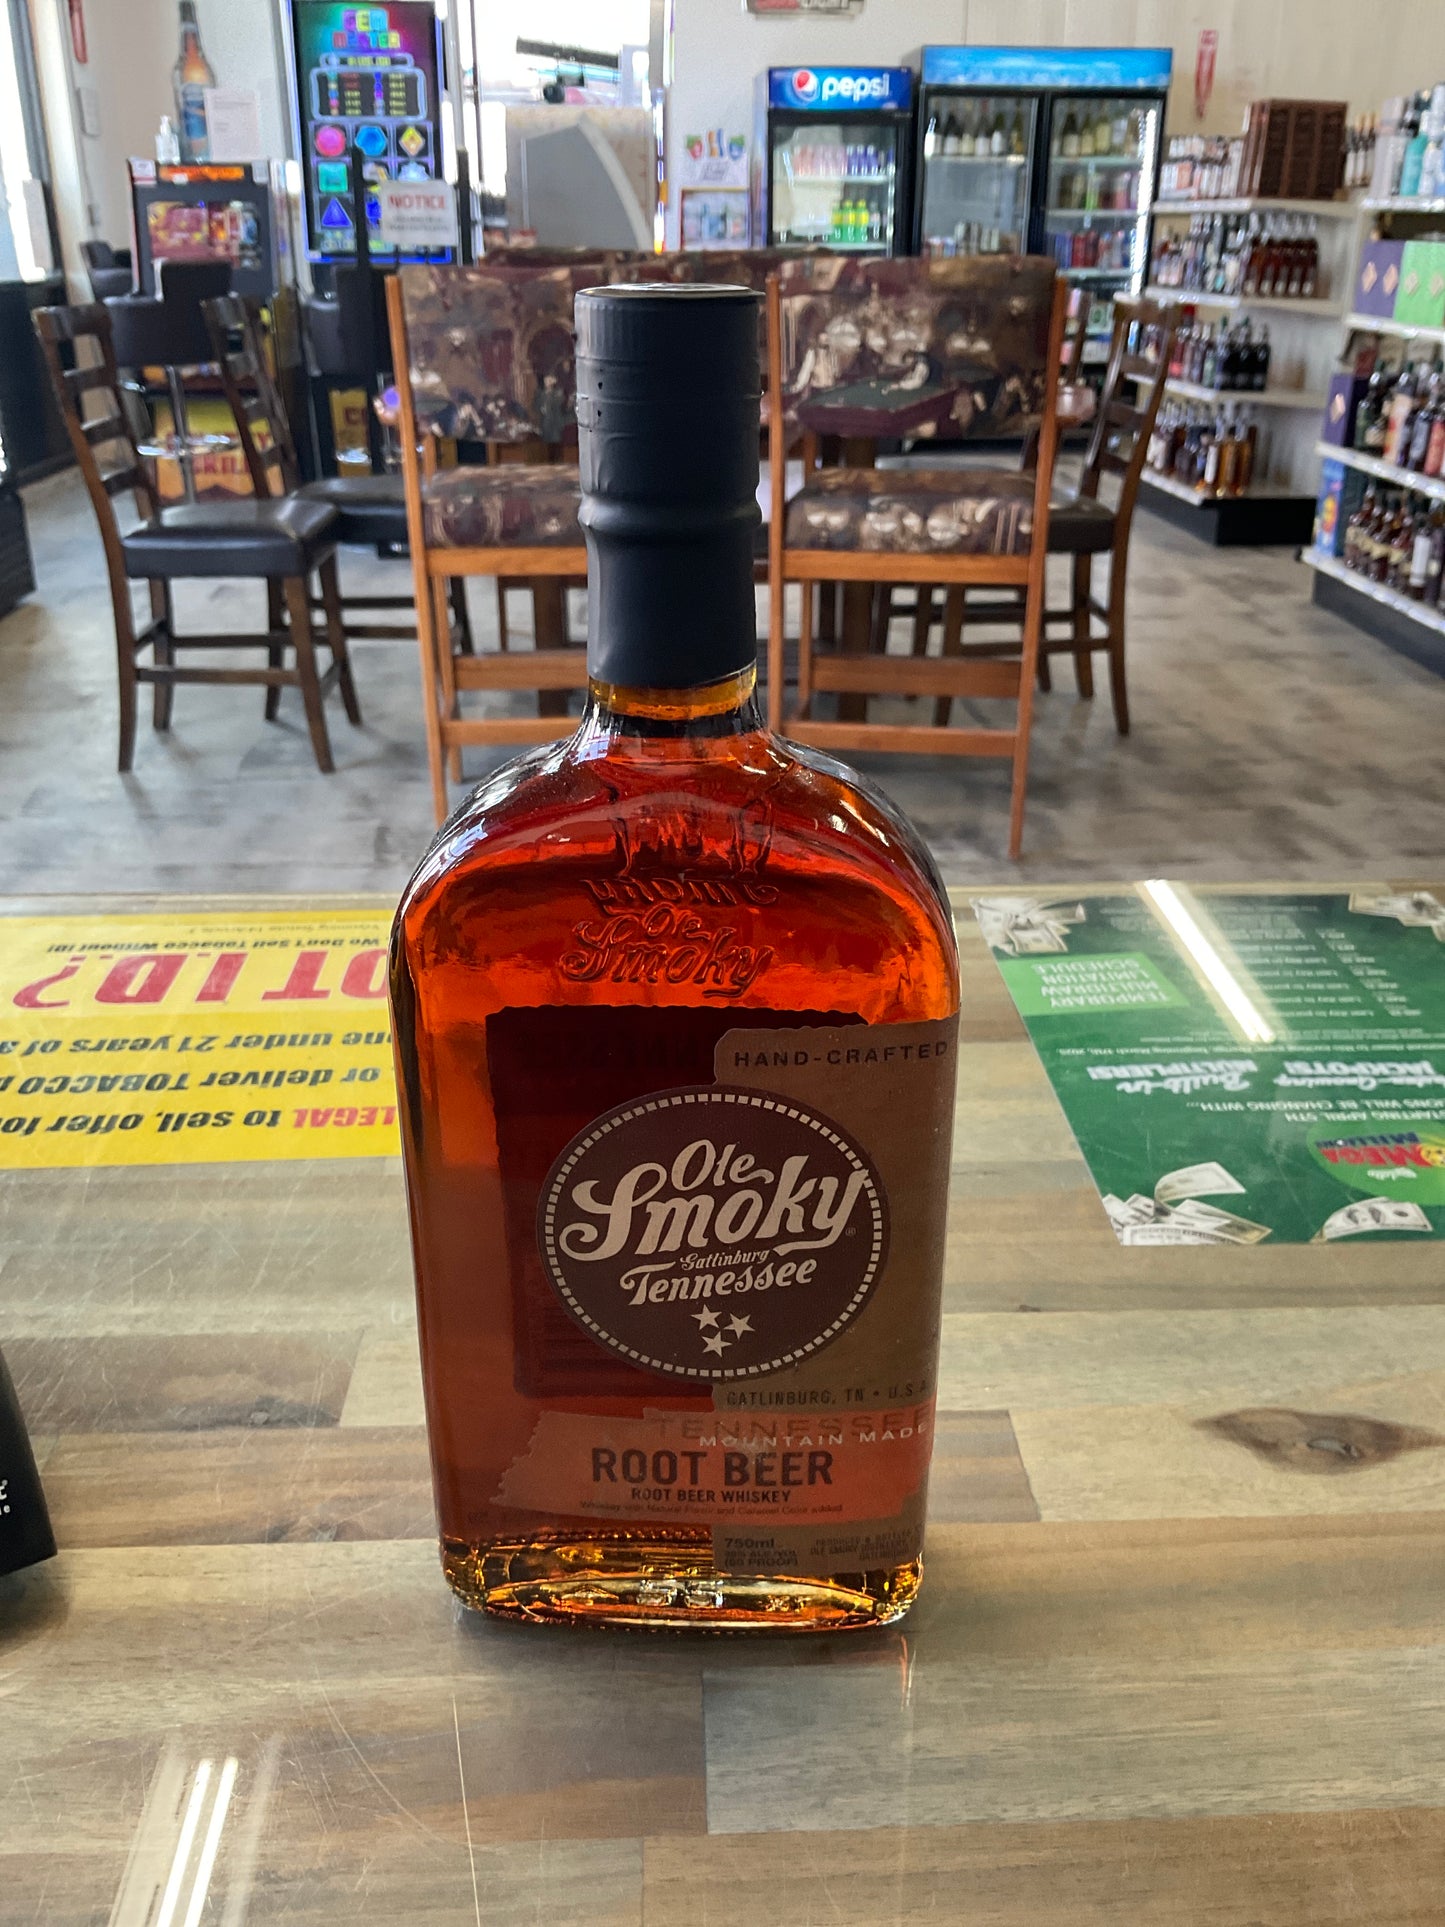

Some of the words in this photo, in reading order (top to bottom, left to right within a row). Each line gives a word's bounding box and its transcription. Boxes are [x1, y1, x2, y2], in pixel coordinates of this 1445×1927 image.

[822, 72, 890, 103] pepsi
[80, 942, 158, 952] Without
[164, 940, 245, 950] Tobacco
[253, 940, 290, 948] Sell
[295, 939, 344, 948] Don't
[349, 938, 380, 946] We
[559, 914, 775, 999] Smoky
[1031, 958, 1140, 974] SCHEDULE
[12, 952, 248, 1009] I.D.?
[261, 948, 388, 1001] OT
[1042, 970, 1150, 985] LIMITATION
[1042, 980, 1158, 996] MULTIDRAW
[1050, 991, 1167, 1007] TEMPORARY
[19, 1039, 62, 1058] of
[69, 1035, 173, 1052] years
[177, 1036, 220, 1052] 21
[224, 1032, 333, 1050] under
[734, 1040, 950, 1068] HAND-CRAFTED
[18, 1073, 190, 1095] TOBACCO
[199, 1068, 333, 1088] deliver
[340, 1067, 381, 1083] or
[1247, 1100, 1333, 1111] CHANGING
[1336, 1100, 1358, 1110] BE
[1360, 1098, 1402, 1110] WILL
[46, 1113, 144, 1136] offer
[156, 1110, 234, 1132] sell,
[243, 1110, 281, 1128] to
[293, 1106, 397, 1128] LEGAL
[1319, 1111, 1366, 1122] APRIL
[0, 1116, 42, 1137] fo
[670, 1138, 775, 1192] Ole
[1318, 1144, 1432, 1168] MEGA
[558, 1154, 870, 1262] Smoky
[678, 1247, 772, 1273] Gatlinburg
[619, 1258, 818, 1306] Tennessee
[726, 1390, 837, 1407] GATLINBURG,
[846, 1388, 864, 1402] TN
[652, 1404, 930, 1440] TENNESSEE
[699, 1433, 843, 1448] MOUNTAIN
[859, 1422, 929, 1443] MADE
[591, 1447, 707, 1486] ROOT
[724, 1449, 834, 1487] BEER
[631, 1487, 671, 1501] ROOT
[677, 1488, 716, 1502] BEER
[721, 1489, 792, 1504] WHISKEY
[724, 1537, 775, 1548] 750ml
